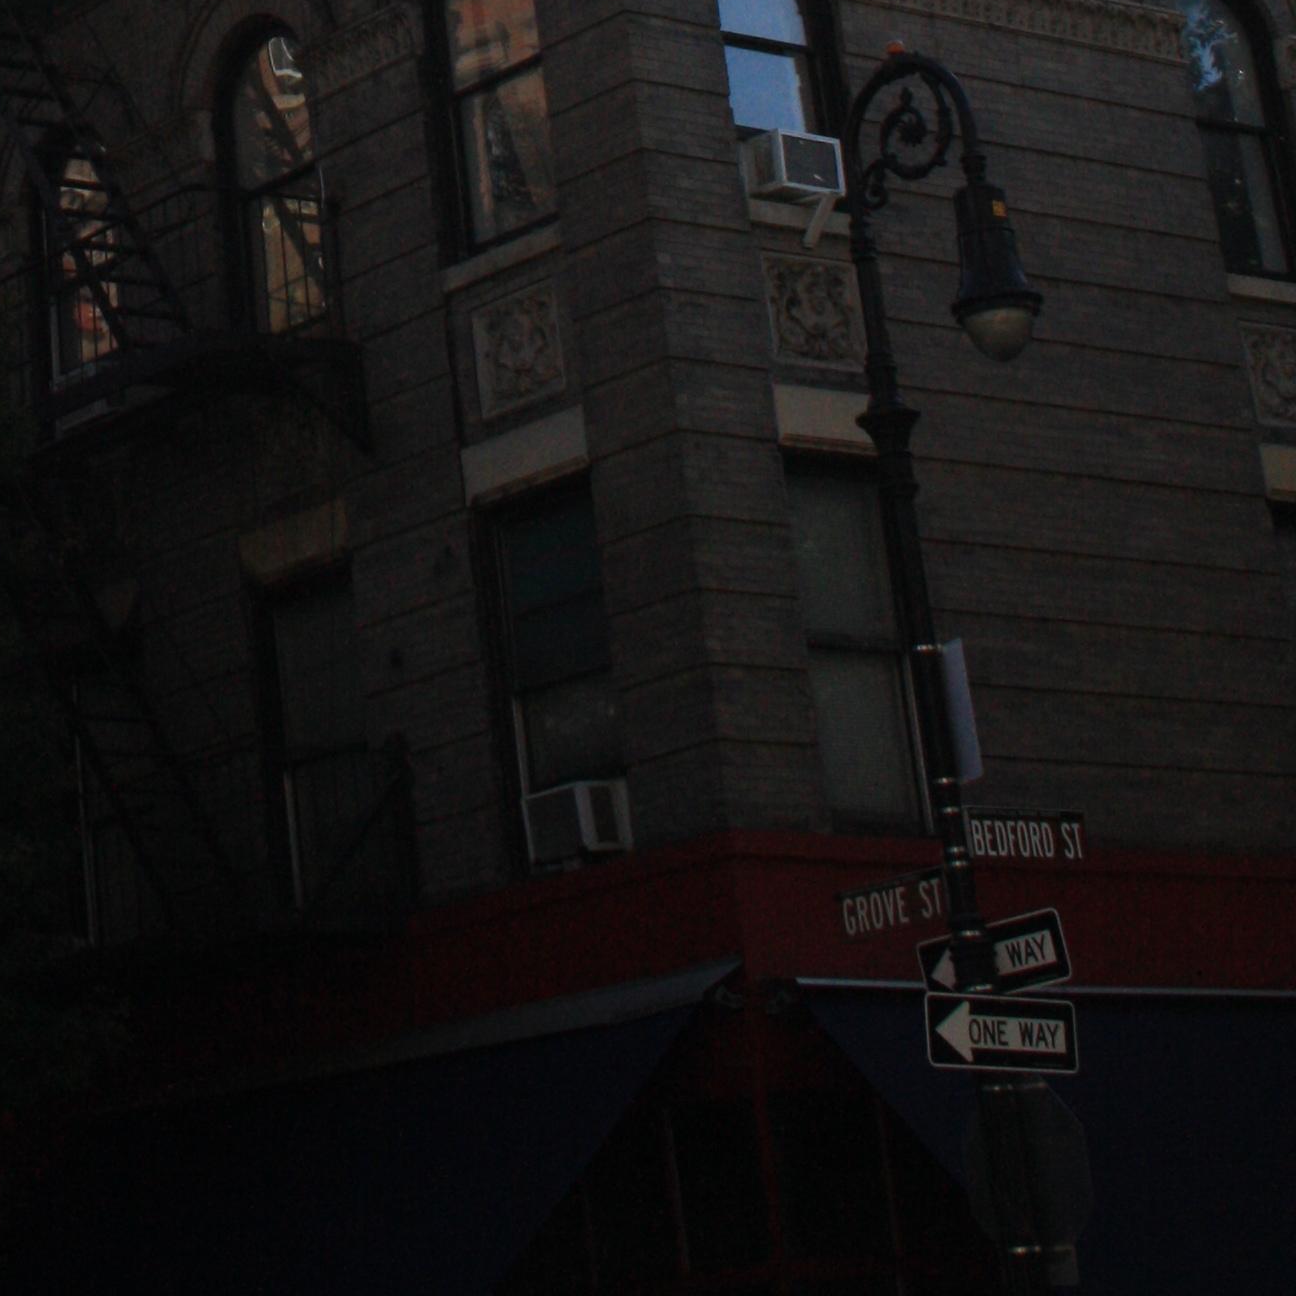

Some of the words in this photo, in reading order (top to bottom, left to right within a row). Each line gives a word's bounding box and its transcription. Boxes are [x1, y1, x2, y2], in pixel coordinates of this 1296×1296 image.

[970, 819, 1055, 858] BEDFORD
[1061, 821, 1084, 859] ST
[842, 887, 909, 936] GROVE
[917, 878, 943, 920] ST
[1005, 934, 1048, 968] WAY
[968, 1018, 1009, 1046] ONE
[1019, 1022, 1059, 1049] WAY
